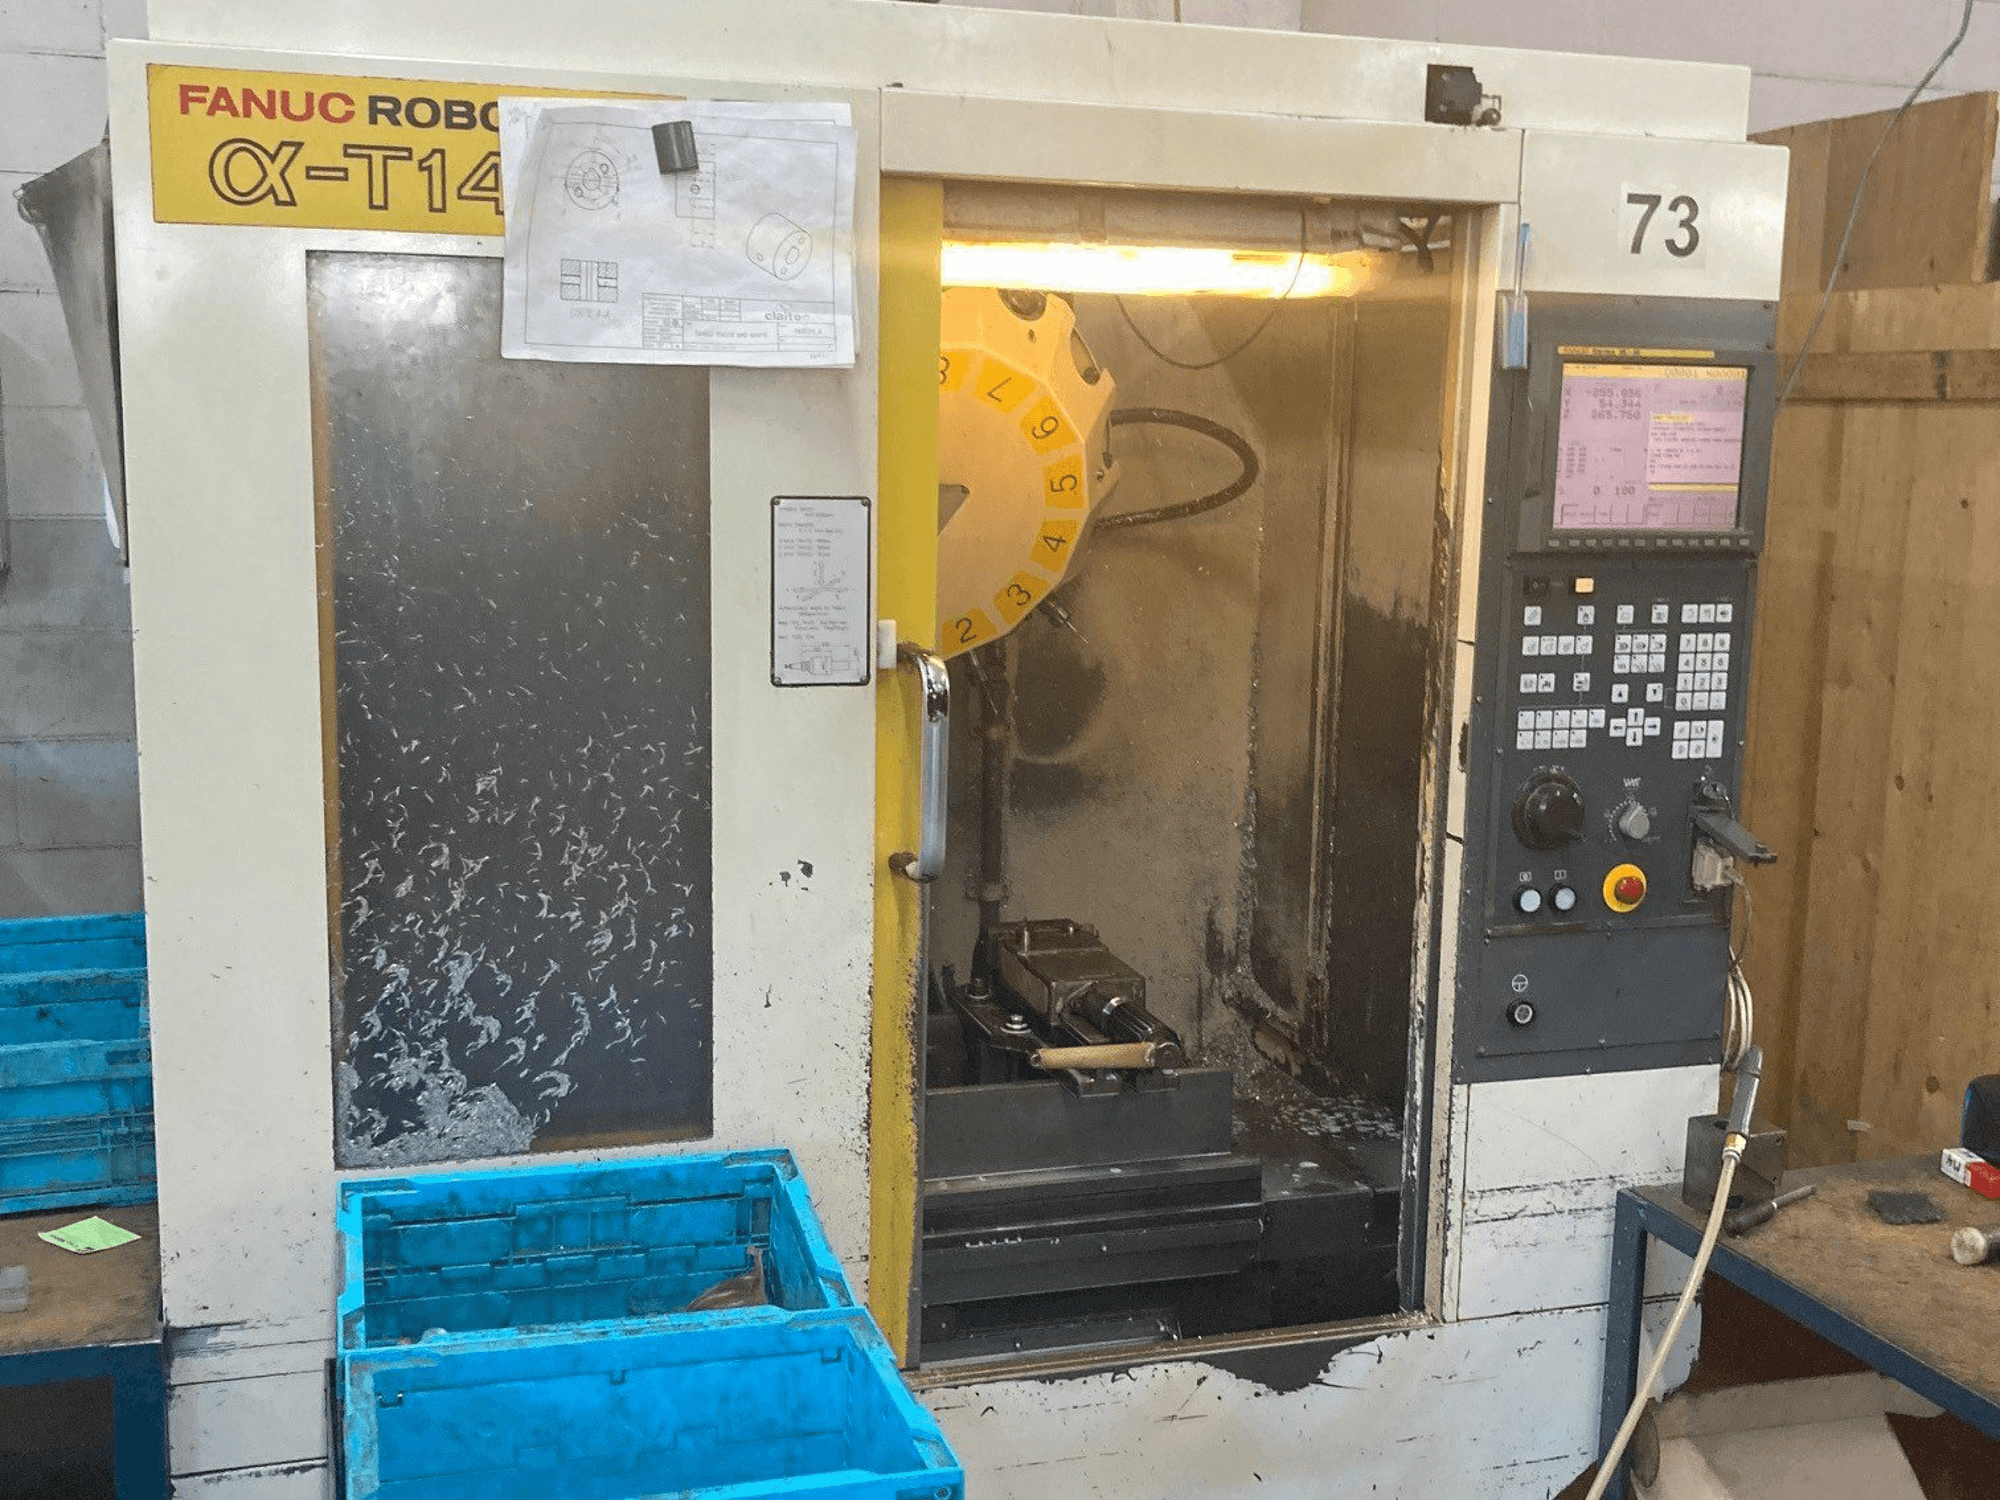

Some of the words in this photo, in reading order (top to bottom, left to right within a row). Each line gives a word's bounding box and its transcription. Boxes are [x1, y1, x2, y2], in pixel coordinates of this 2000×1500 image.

[179, 84, 355, 124] FANUC
[1627, 193, 1699, 257] 73
[986, 377, 1012, 403] 7
[1050, 474, 1078, 493] 5
[1042, 535, 1066, 553] 4
[1007, 584, 1032, 607] 3
[956, 617, 978, 644] 2
